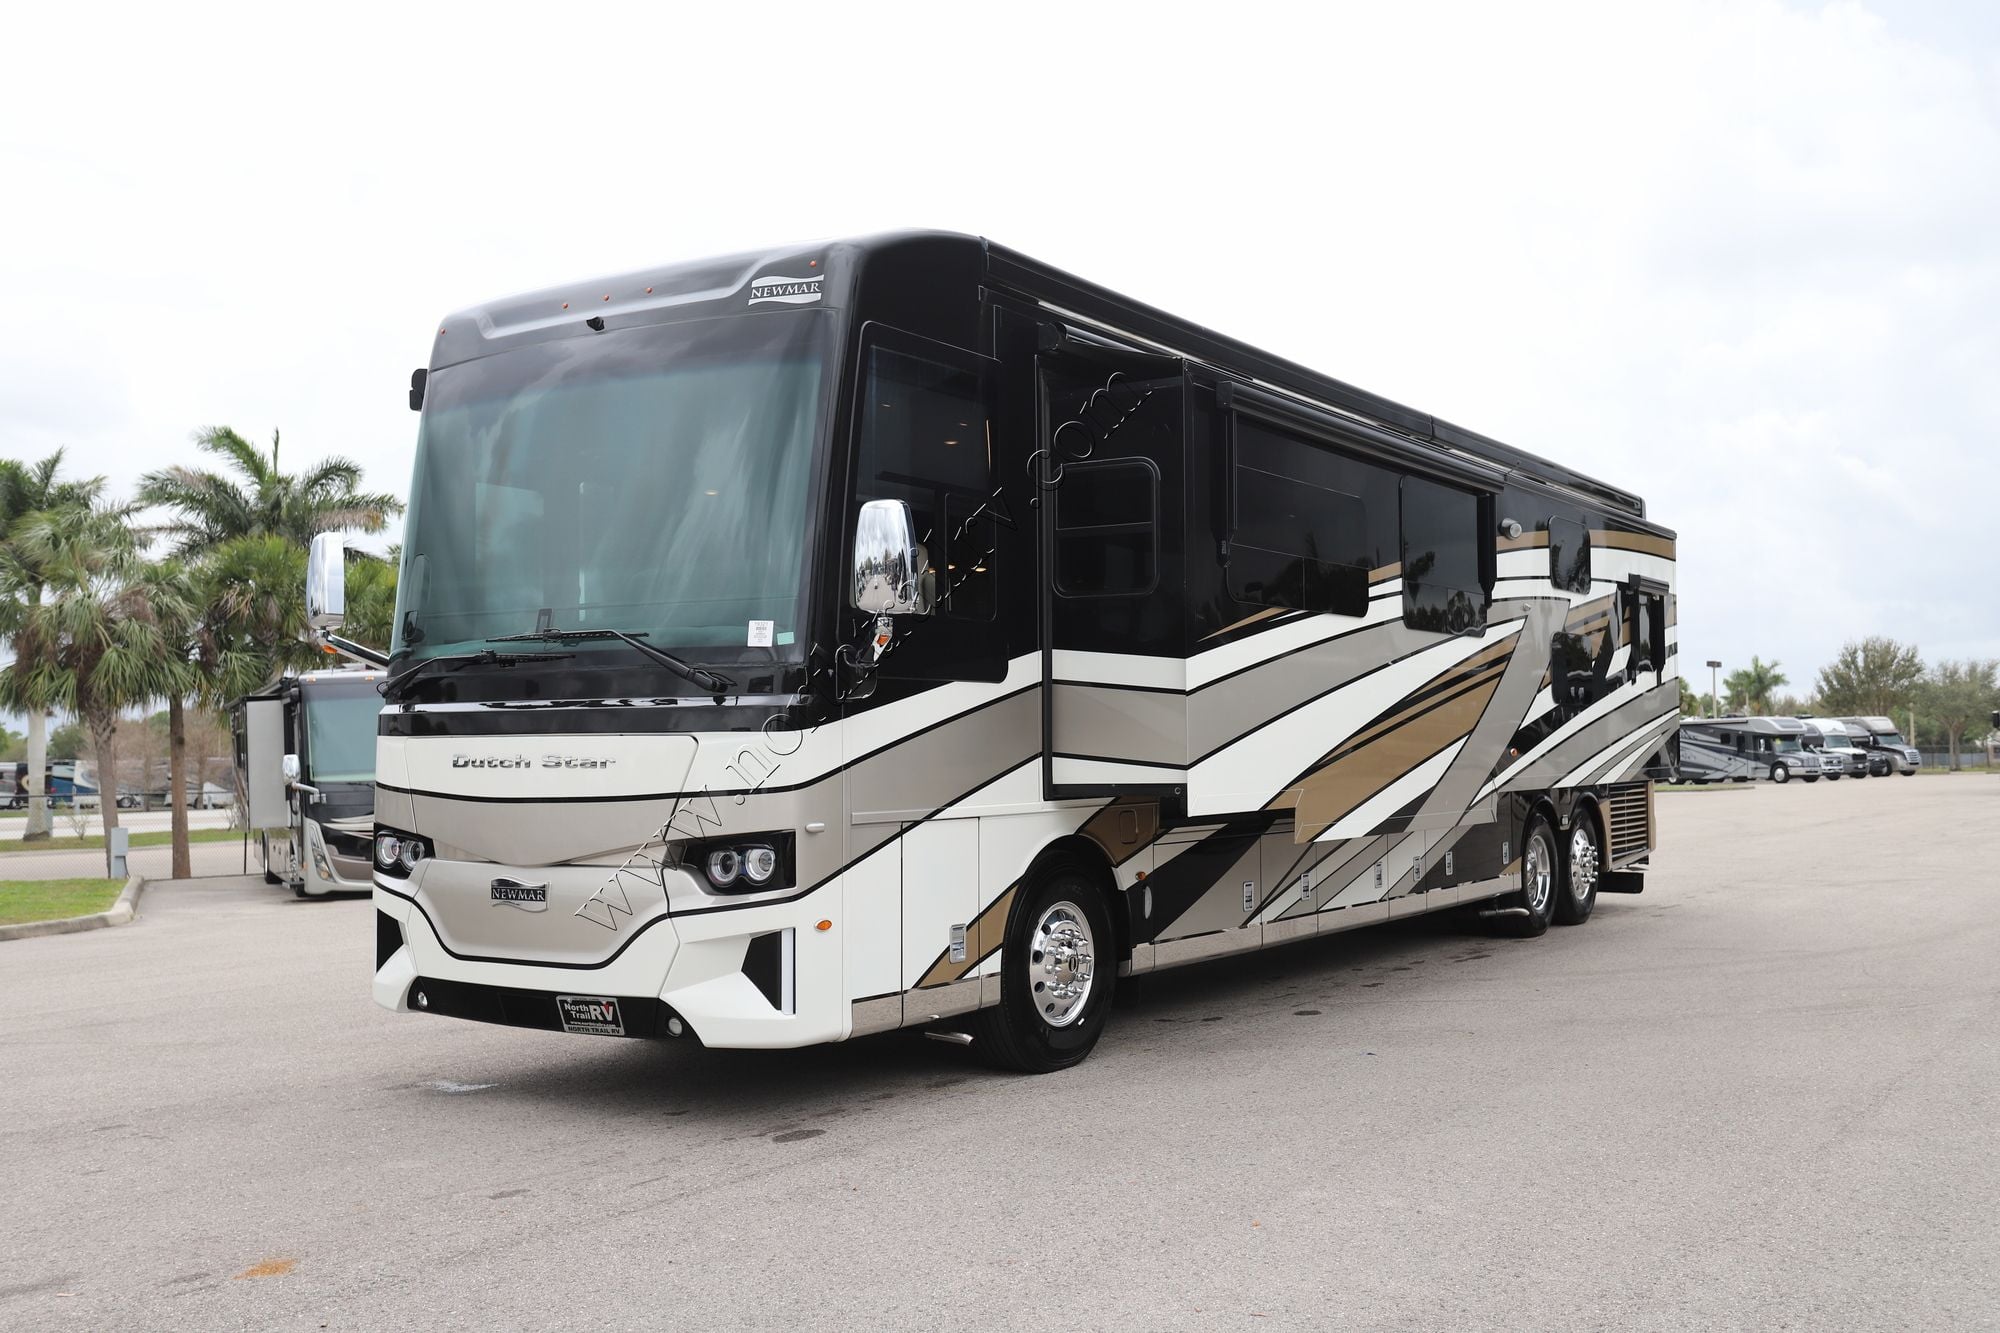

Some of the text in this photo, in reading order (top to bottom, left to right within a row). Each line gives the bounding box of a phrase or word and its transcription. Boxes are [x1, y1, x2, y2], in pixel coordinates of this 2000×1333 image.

[750, 282, 821, 299] NEWMAR
[452, 754, 616, 769] Dutch Star
[492, 888, 545, 901] NEWMAR
[564, 1003, 589, 1012] North
[589, 1005, 613, 1021] RV
[570, 1010, 591, 1020] Trail
